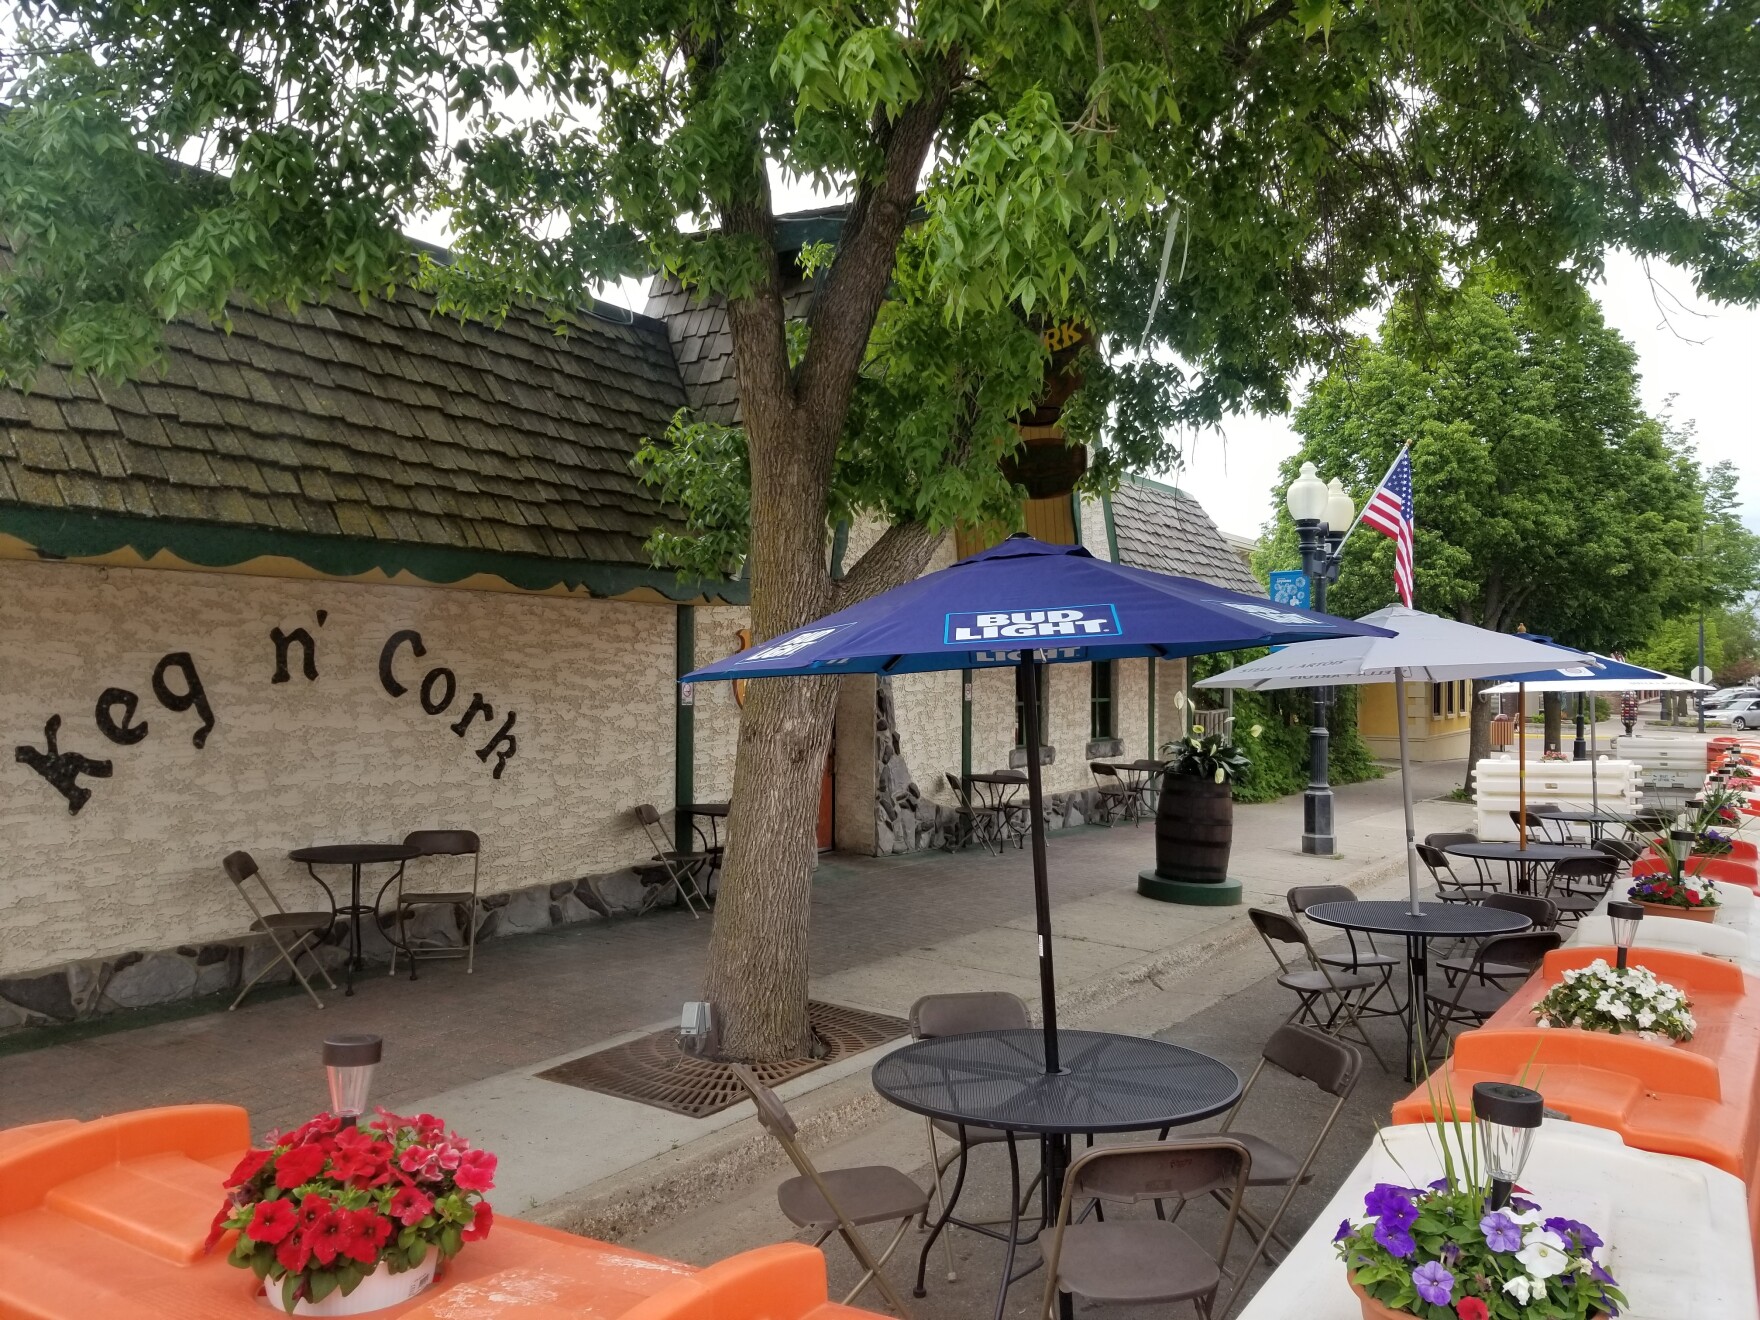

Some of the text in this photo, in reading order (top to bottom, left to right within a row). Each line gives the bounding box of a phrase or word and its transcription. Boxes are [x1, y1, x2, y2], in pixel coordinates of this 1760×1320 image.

[955, 618, 1109, 641] LIGHT
[976, 609, 1084, 628] BUD
[14, 651, 216, 817] Keg
[378, 629, 518, 780] Cork
